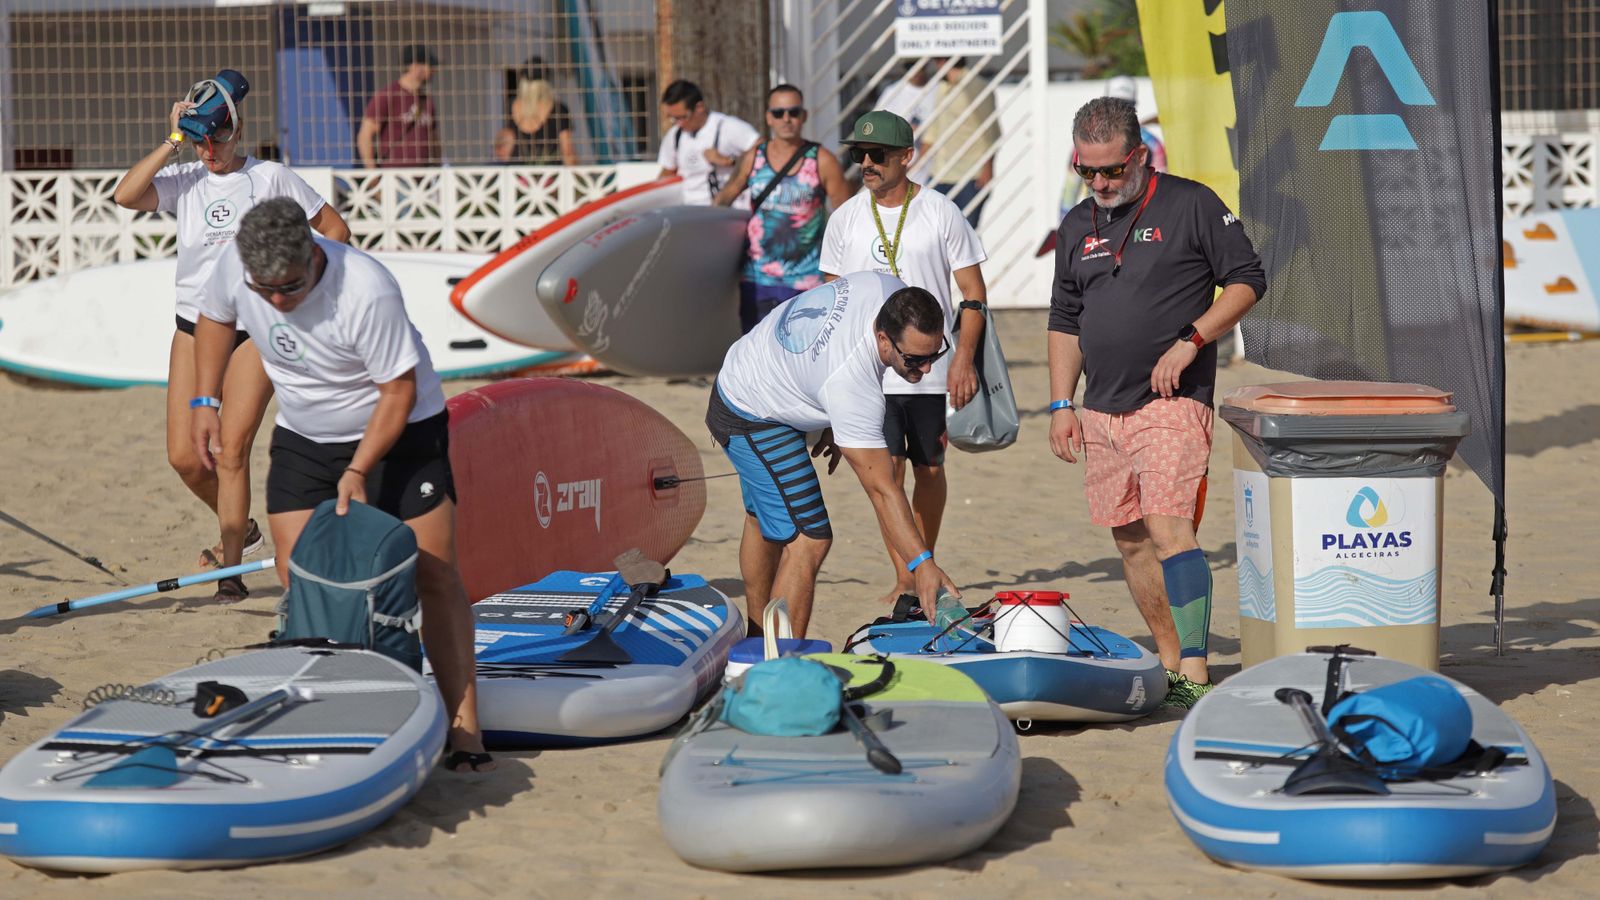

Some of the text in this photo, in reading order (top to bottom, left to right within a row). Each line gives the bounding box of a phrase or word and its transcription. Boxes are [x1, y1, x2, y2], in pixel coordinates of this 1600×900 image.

[909, 22, 989, 31] SOLO SOCIOS
[901, 39, 997, 49] ONLY PARTNERS
[1133, 227, 1163, 243] KEA
[834, 296, 849, 313] POR
[830, 313, 842, 323] EL
[811, 322, 836, 362] MUNDO
[1322, 531, 1412, 550] PLAYAS
[1336, 551, 1400, 559] ALGECIRAS
